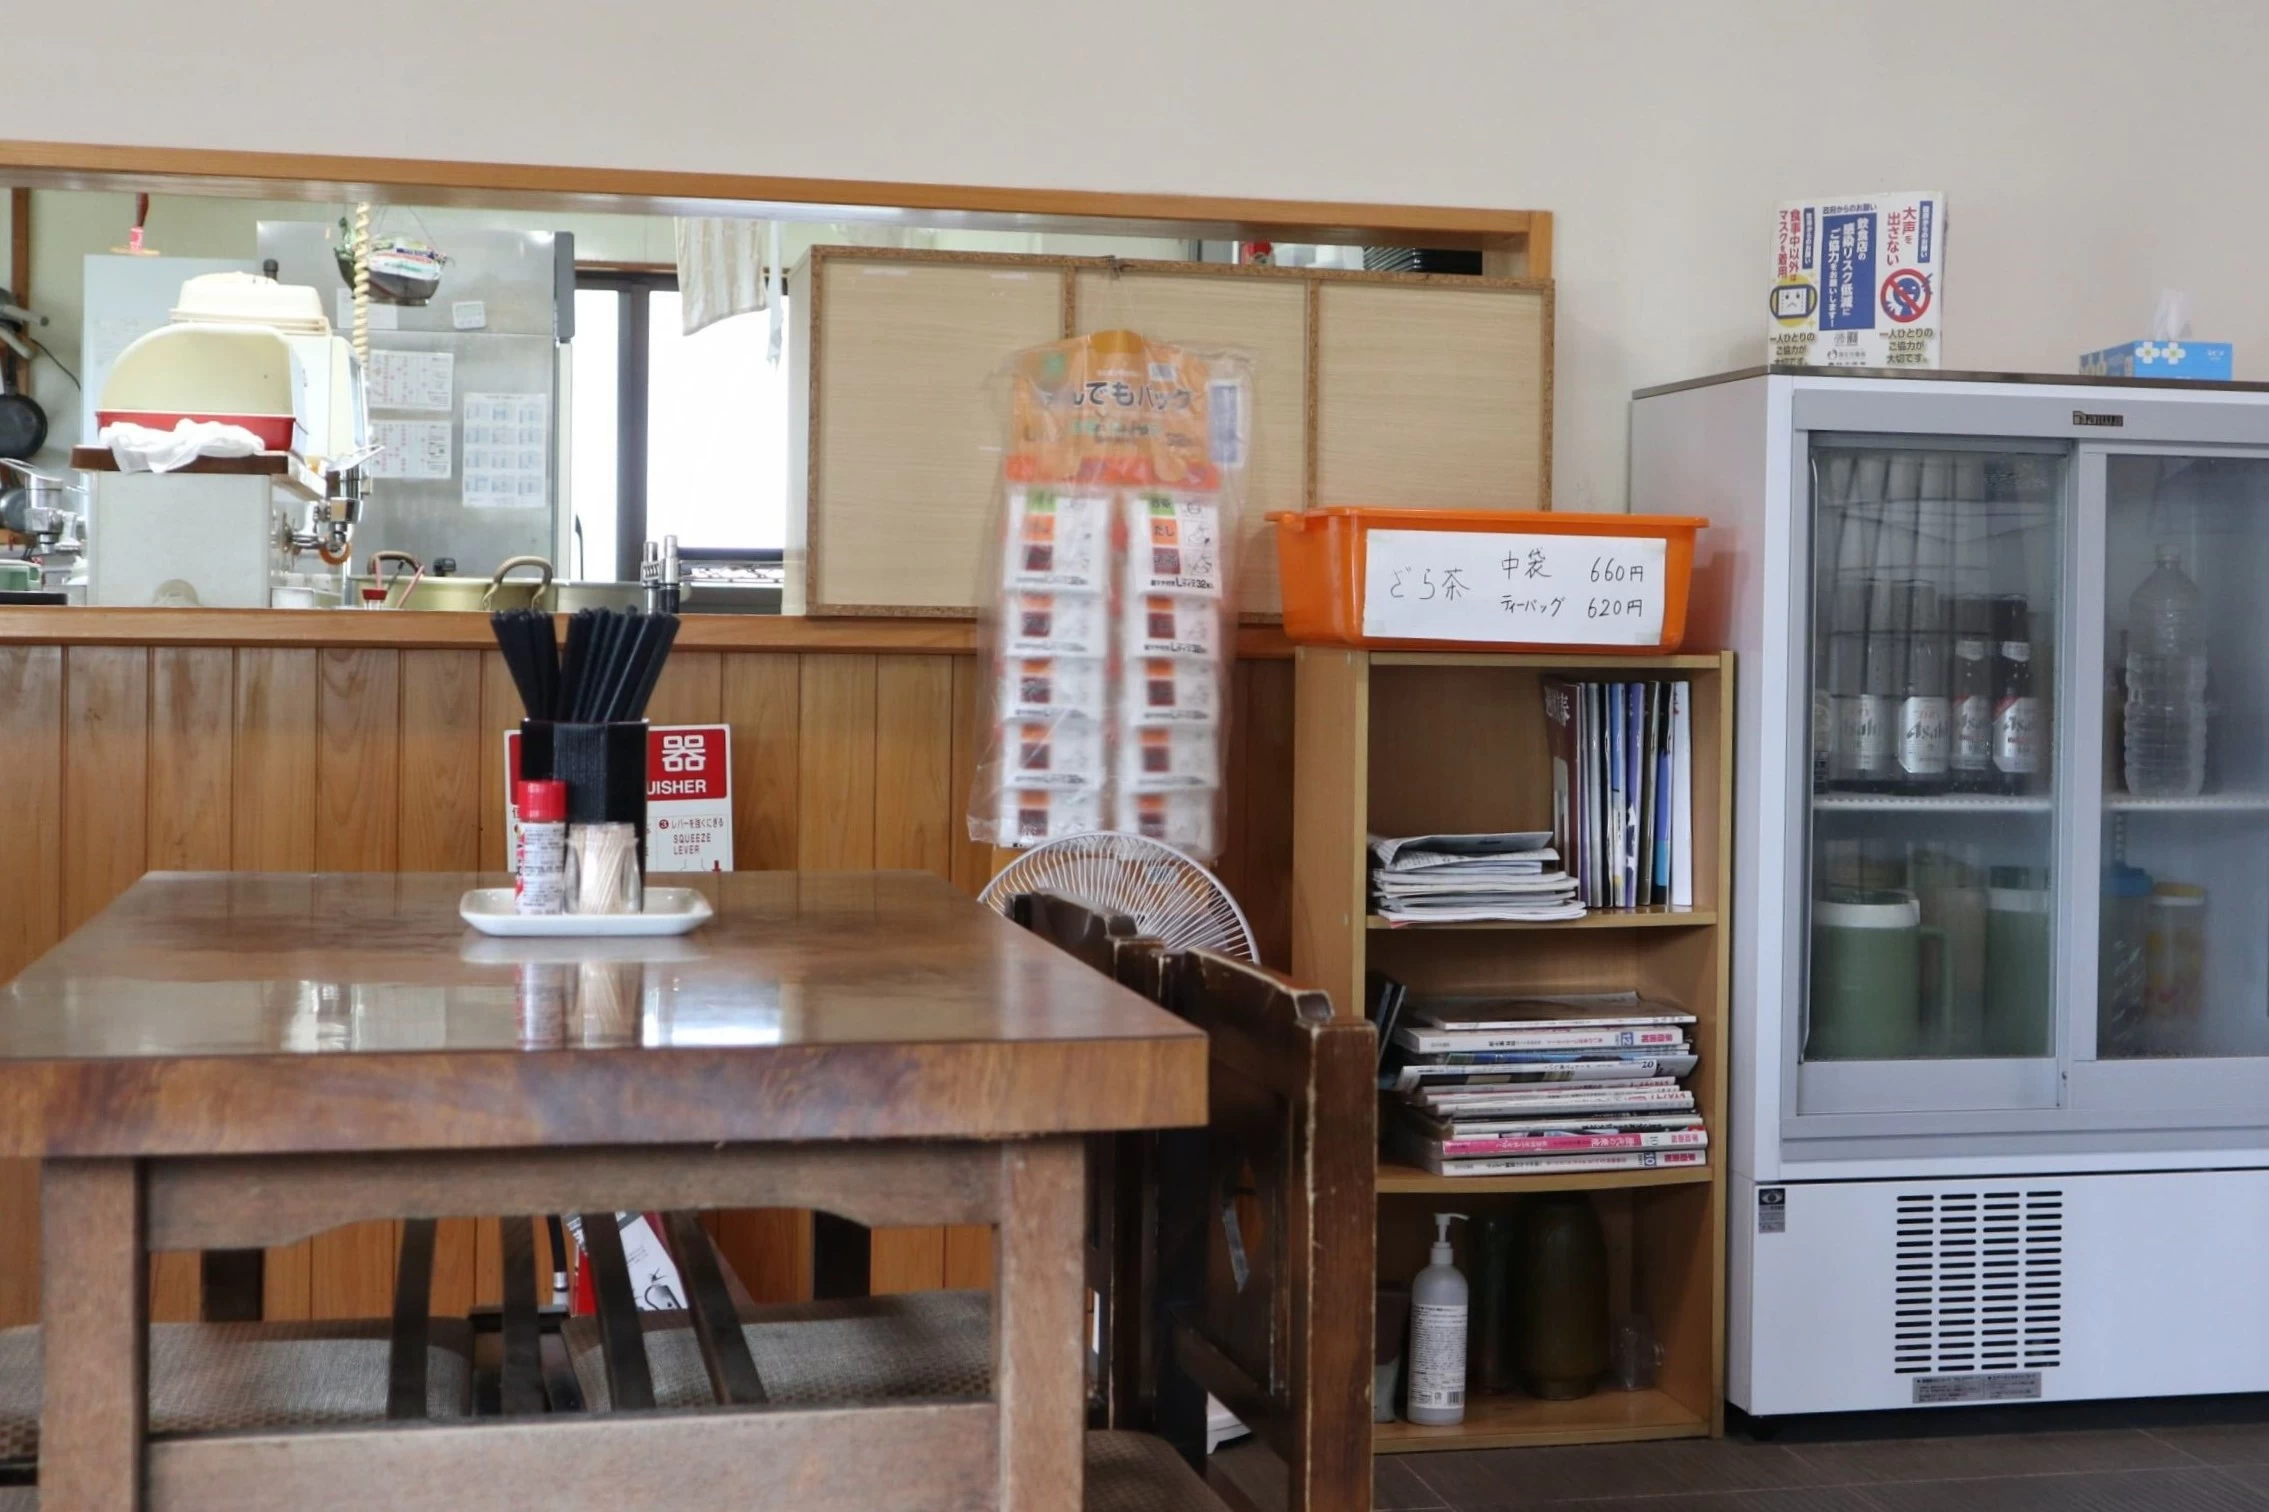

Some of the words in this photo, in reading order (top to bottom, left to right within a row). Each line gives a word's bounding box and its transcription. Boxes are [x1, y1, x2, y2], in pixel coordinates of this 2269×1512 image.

[1823, 203, 1877, 214] 政府からのお願い
[1902, 206, 1917, 245] 大声を
[1777, 210, 1788, 279] マスクを着用
[1789, 208, 1801, 281] 食事中以外は
[1856, 217, 1869, 261] 飲食店の
[1886, 211, 1900, 266] 出さない
[1840, 222, 1855, 316] 感染リスク低減に
[1769, 332, 1815, 344] 一人ひとりの
[1879, 328, 1934, 340] 一人ひとりの
[1888, 340, 1925, 352] ご協力が
[1776, 344, 1807, 356] ご協力が
[1501, 546, 1552, 581] 中袋
[1590, 556, 1643, 583] 660円
[1500, 594, 1566, 618] ティーバッグ
[1587, 597, 1642, 619] 620円
[673, 833, 711, 844] SQUEEZE
[673, 845, 700, 855] LEVER
